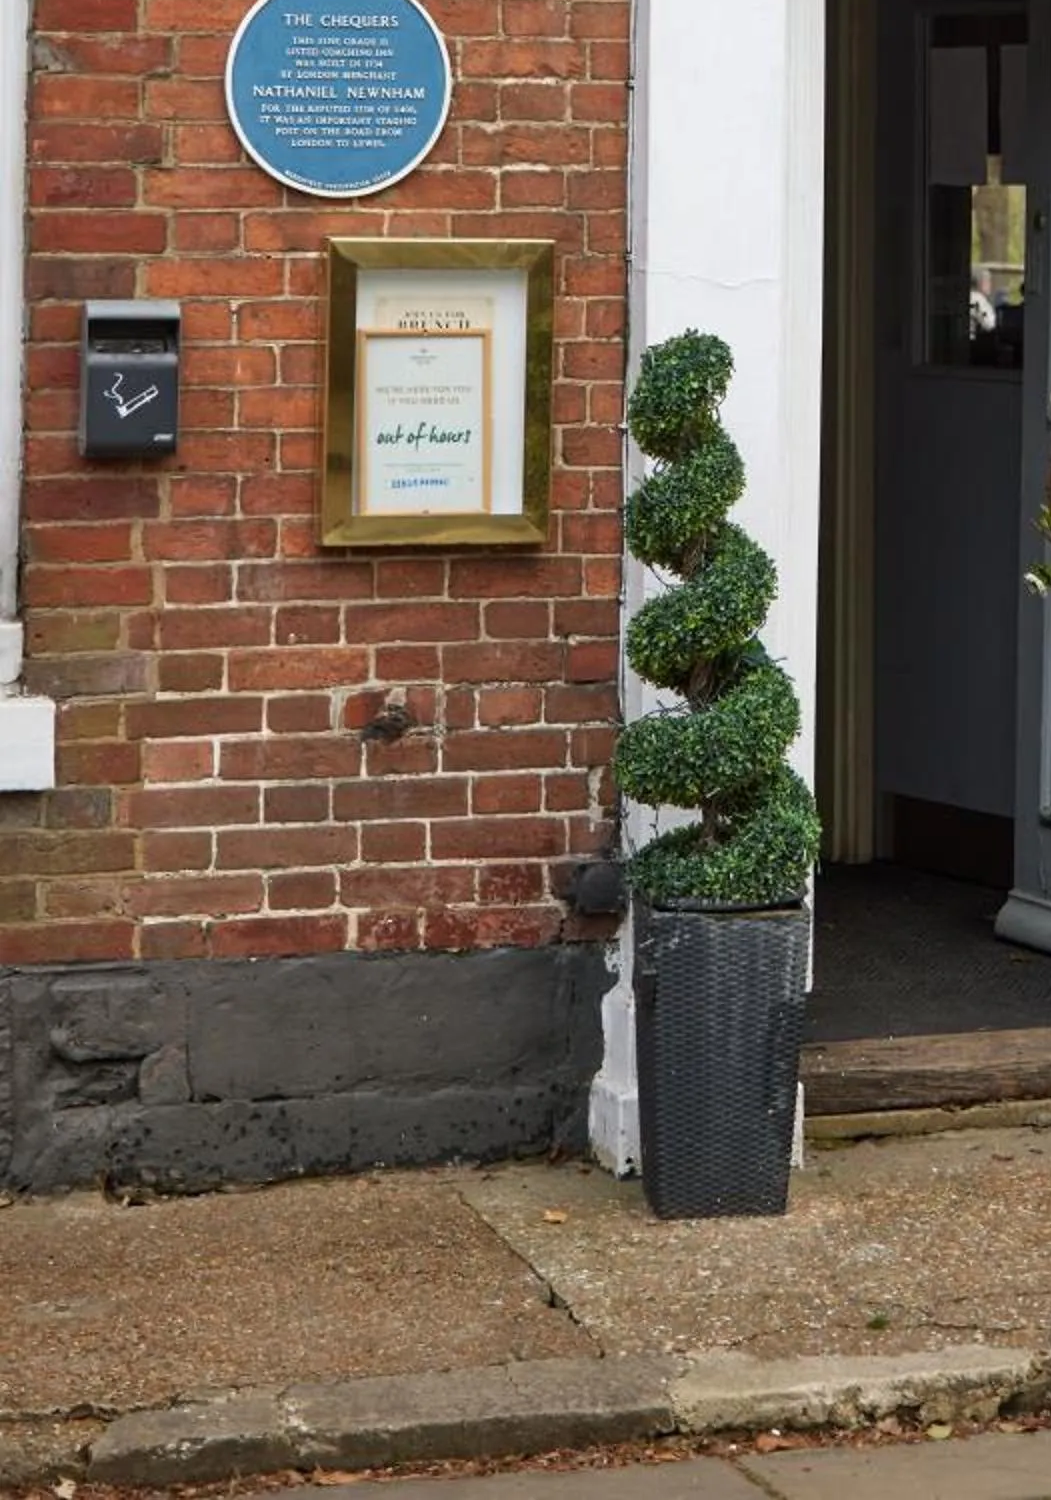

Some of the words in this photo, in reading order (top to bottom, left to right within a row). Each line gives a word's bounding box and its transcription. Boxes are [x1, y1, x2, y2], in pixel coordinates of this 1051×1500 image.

[282, 13, 314, 28] THE
[320, 14, 400, 29] CHEQUERS
[252, 85, 338, 99] NATHANIEL
[346, 86, 426, 100] NEWNHAM
[376, 423, 404, 446] out
[406, 421, 428, 453] of
[429, 425, 472, 445] hours
